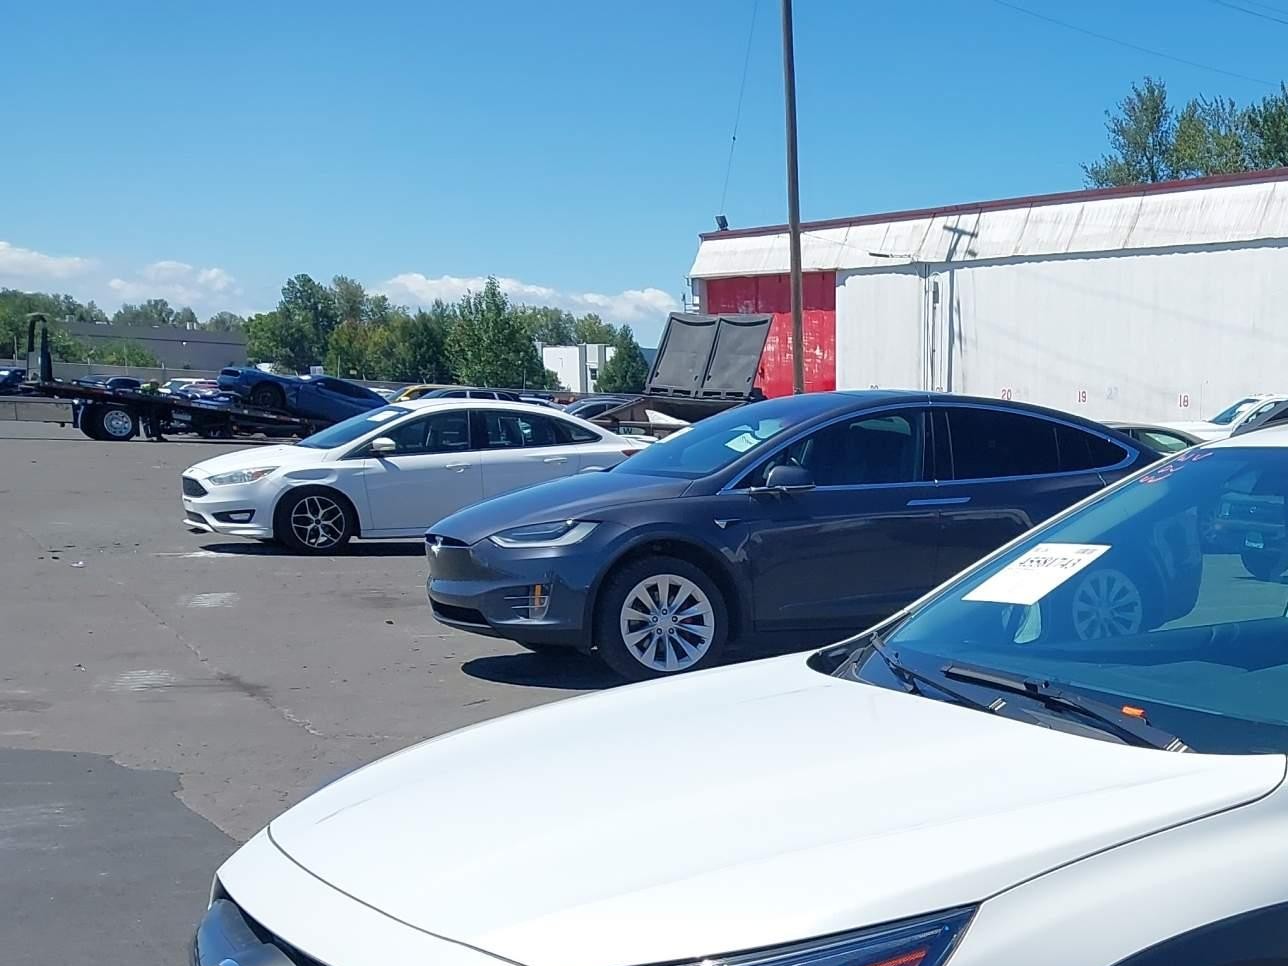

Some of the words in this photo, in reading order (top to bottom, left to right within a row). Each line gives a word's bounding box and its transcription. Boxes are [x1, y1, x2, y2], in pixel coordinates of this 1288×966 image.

[1001, 389, 1012, 400] 20
[1078, 391, 1087, 403] 19
[1179, 394, 1189, 407] 18
